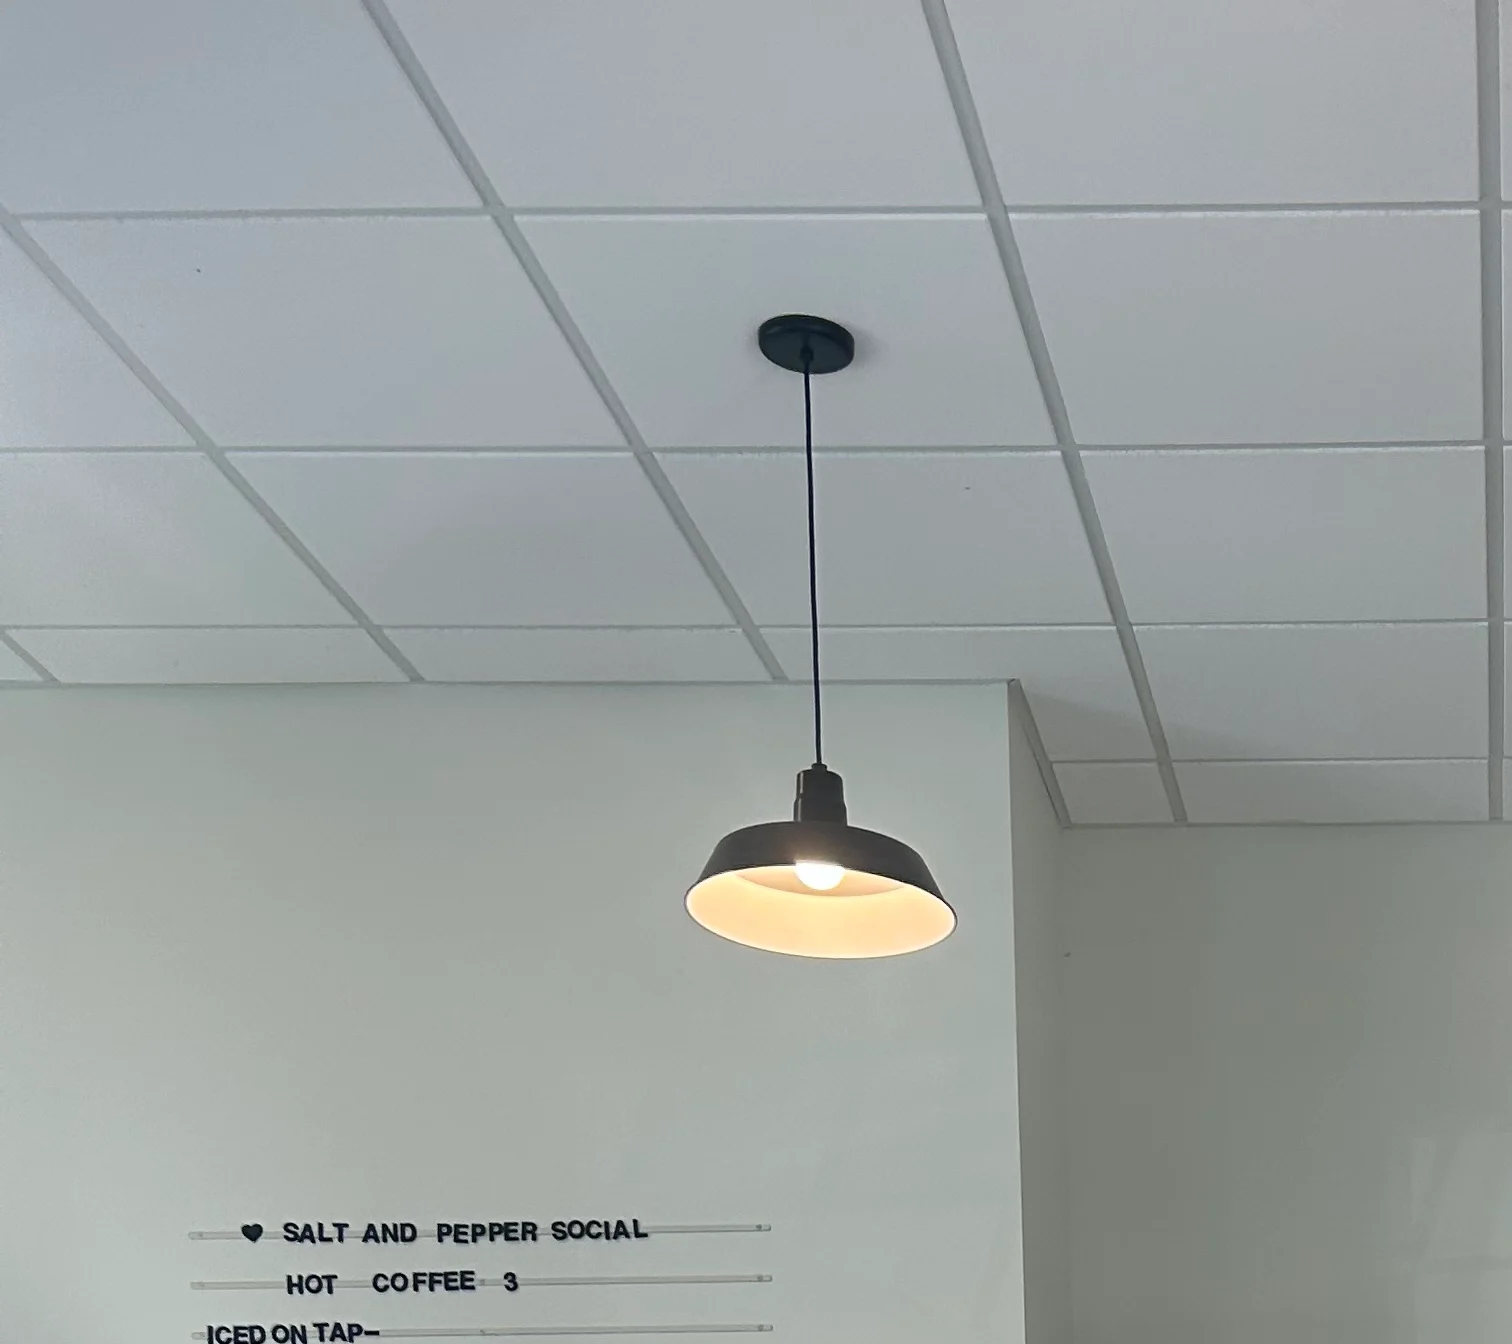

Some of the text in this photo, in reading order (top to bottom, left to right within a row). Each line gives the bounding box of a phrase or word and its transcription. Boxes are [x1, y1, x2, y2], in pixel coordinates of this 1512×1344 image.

[283, 1219, 648, 1244] SALT AND PEPPER SOCIAL
[287, 1271, 518, 1294] HOT COFFEE 3
[208, 1326, 266, 1344] ICED
[272, 1325, 307, 1344] ON
